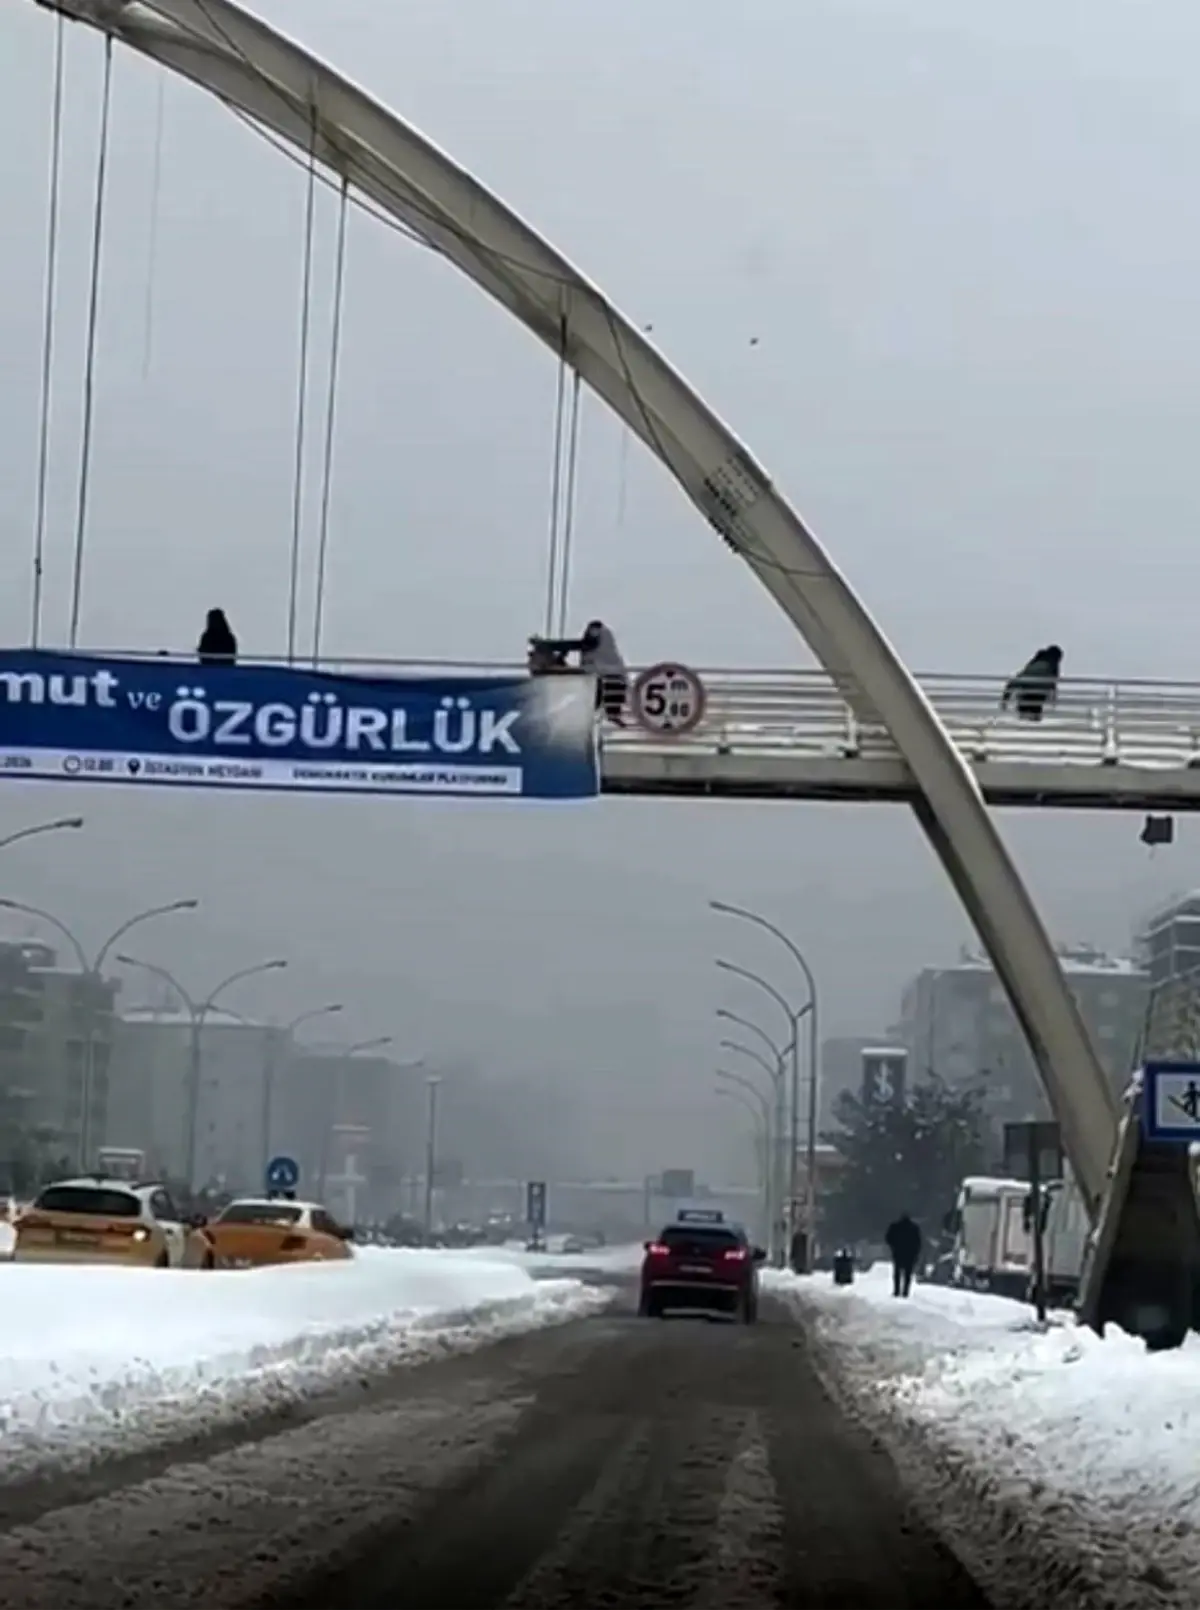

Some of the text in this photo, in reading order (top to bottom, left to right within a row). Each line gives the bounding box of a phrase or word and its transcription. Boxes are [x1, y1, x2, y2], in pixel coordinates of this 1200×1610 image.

[127, 691, 162, 711] ve
[168, 685, 522, 753] ÖZGÜRLÜK
[645, 683, 667, 716] 5
